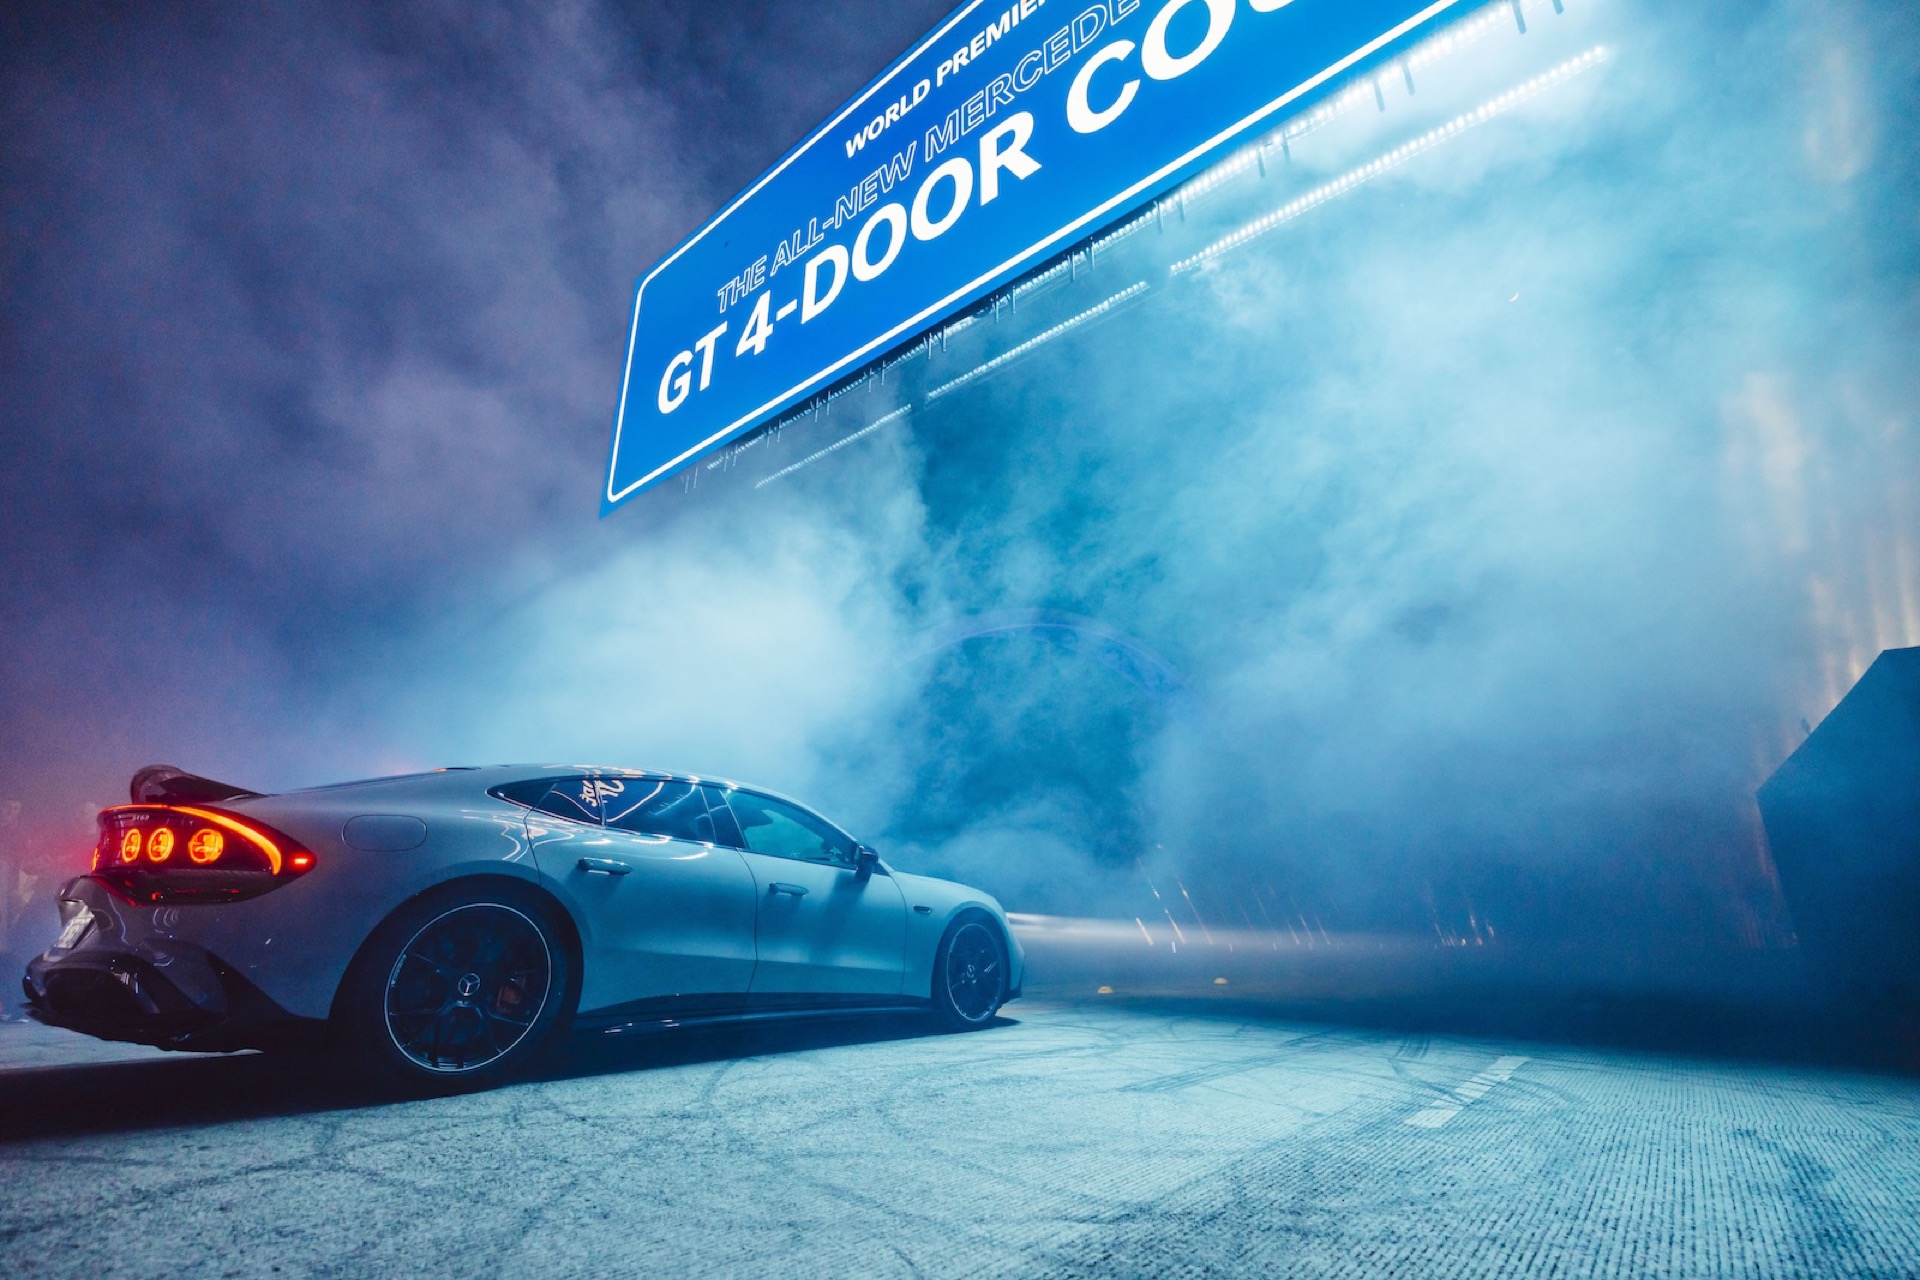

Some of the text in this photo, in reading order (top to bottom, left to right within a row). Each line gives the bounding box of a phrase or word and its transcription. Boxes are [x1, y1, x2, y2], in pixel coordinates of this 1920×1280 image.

[845, 0, 1046, 158] WORLD PREMIE
[658, 0, 1297, 415] GT 4-DOOR CO
[717, 254, 768, 314] THE
[770, 140, 917, 277] ALL-NEW
